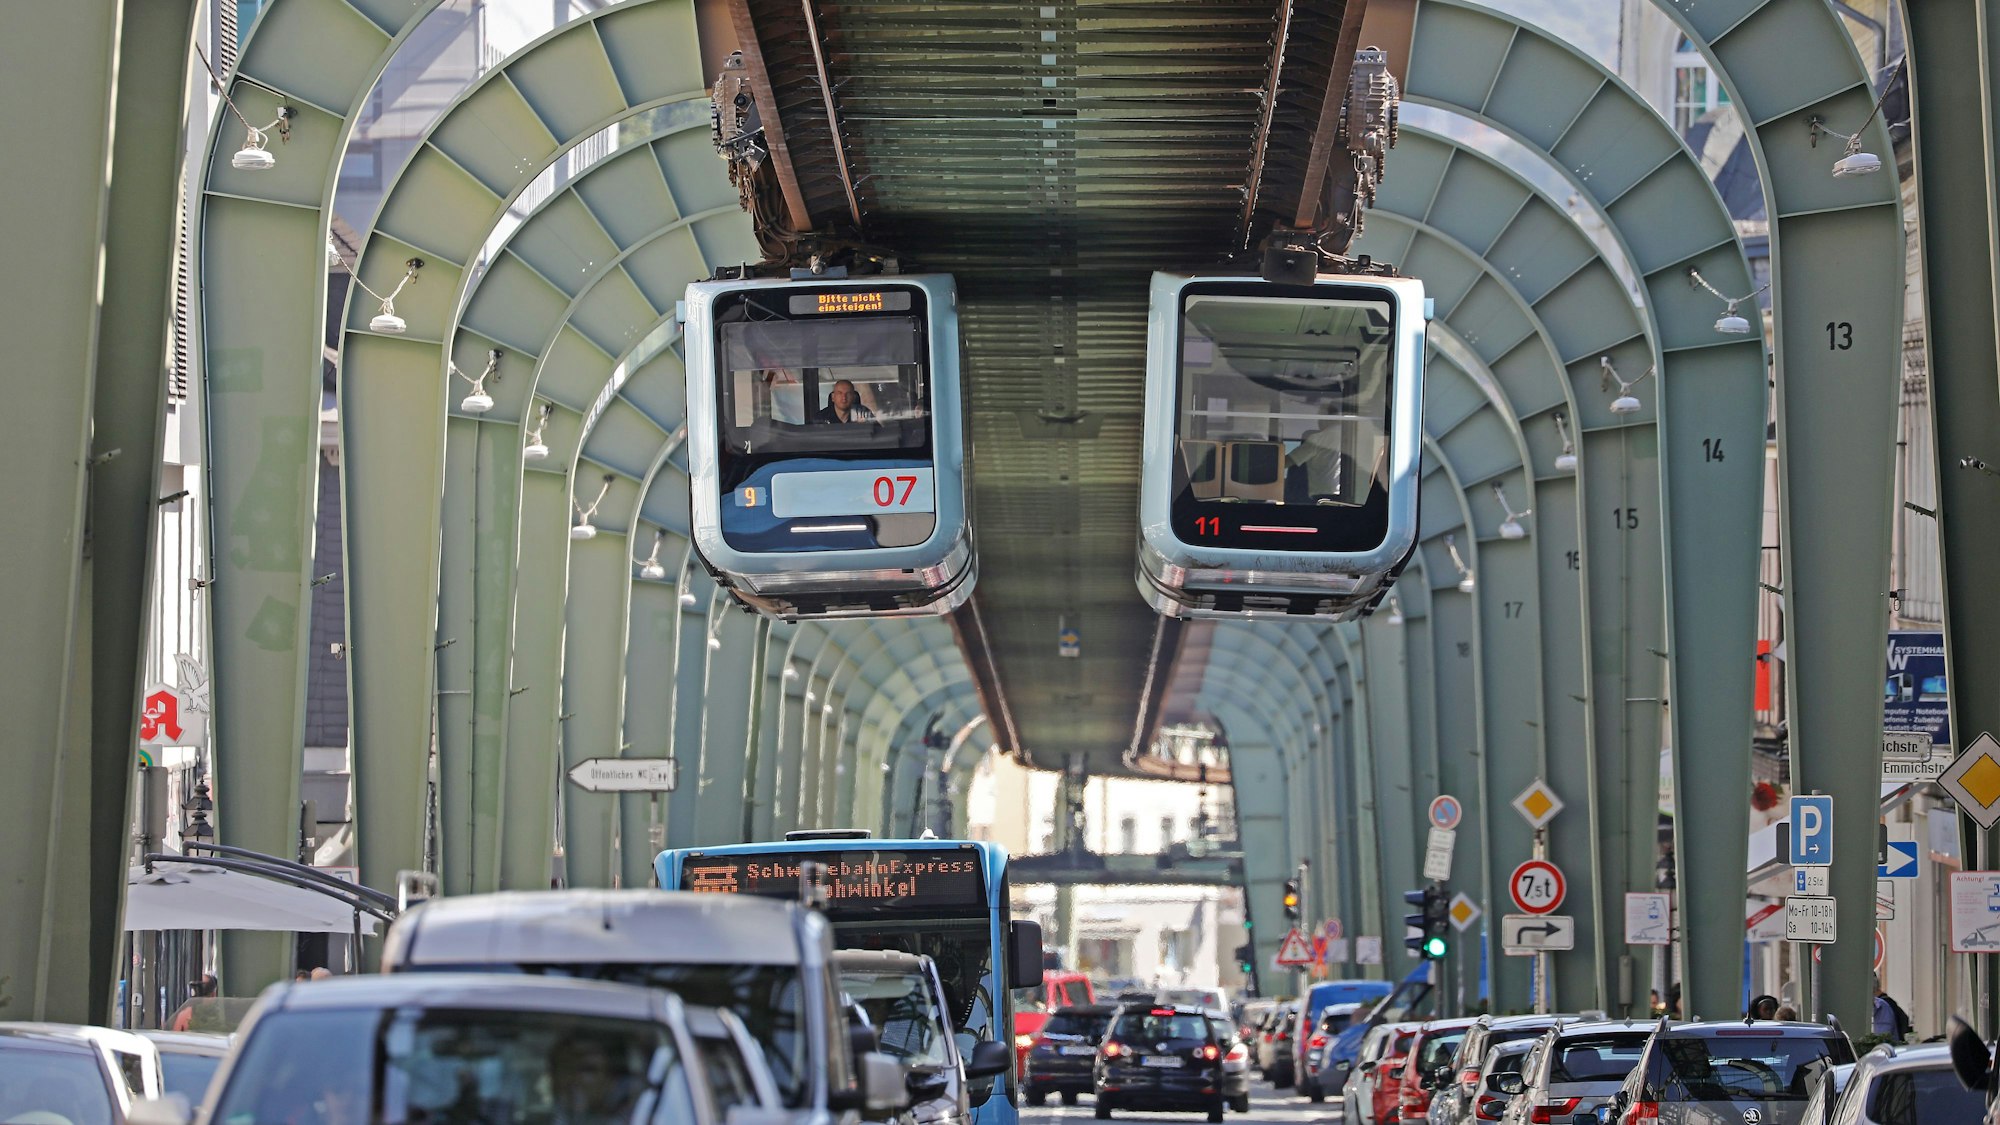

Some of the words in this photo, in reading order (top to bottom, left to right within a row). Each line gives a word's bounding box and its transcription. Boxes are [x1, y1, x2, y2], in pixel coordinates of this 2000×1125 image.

[818, 294, 848, 304] Bitte
[851, 293, 881, 303] nicht
[818, 302, 882, 312] einsteigen!
[1826, 322, 1853, 350] 13
[1703, 438, 1725, 463] 14
[744, 487, 756, 507] 9
[873, 476, 918, 507] 07
[1195, 516, 1220, 536] 11
[1613, 508, 1639, 530] 15
[1504, 602, 1524, 619] 17
[1799, 805, 1822, 856] P
[1807, 877, 1811, 886] 2
[1788, 905, 1809, 917] Mo-Fr
[1811, 905, 1833, 918] 10-18h
[1788, 921, 1797, 933] Sa
[1811, 922, 1833, 934] 10-14h
